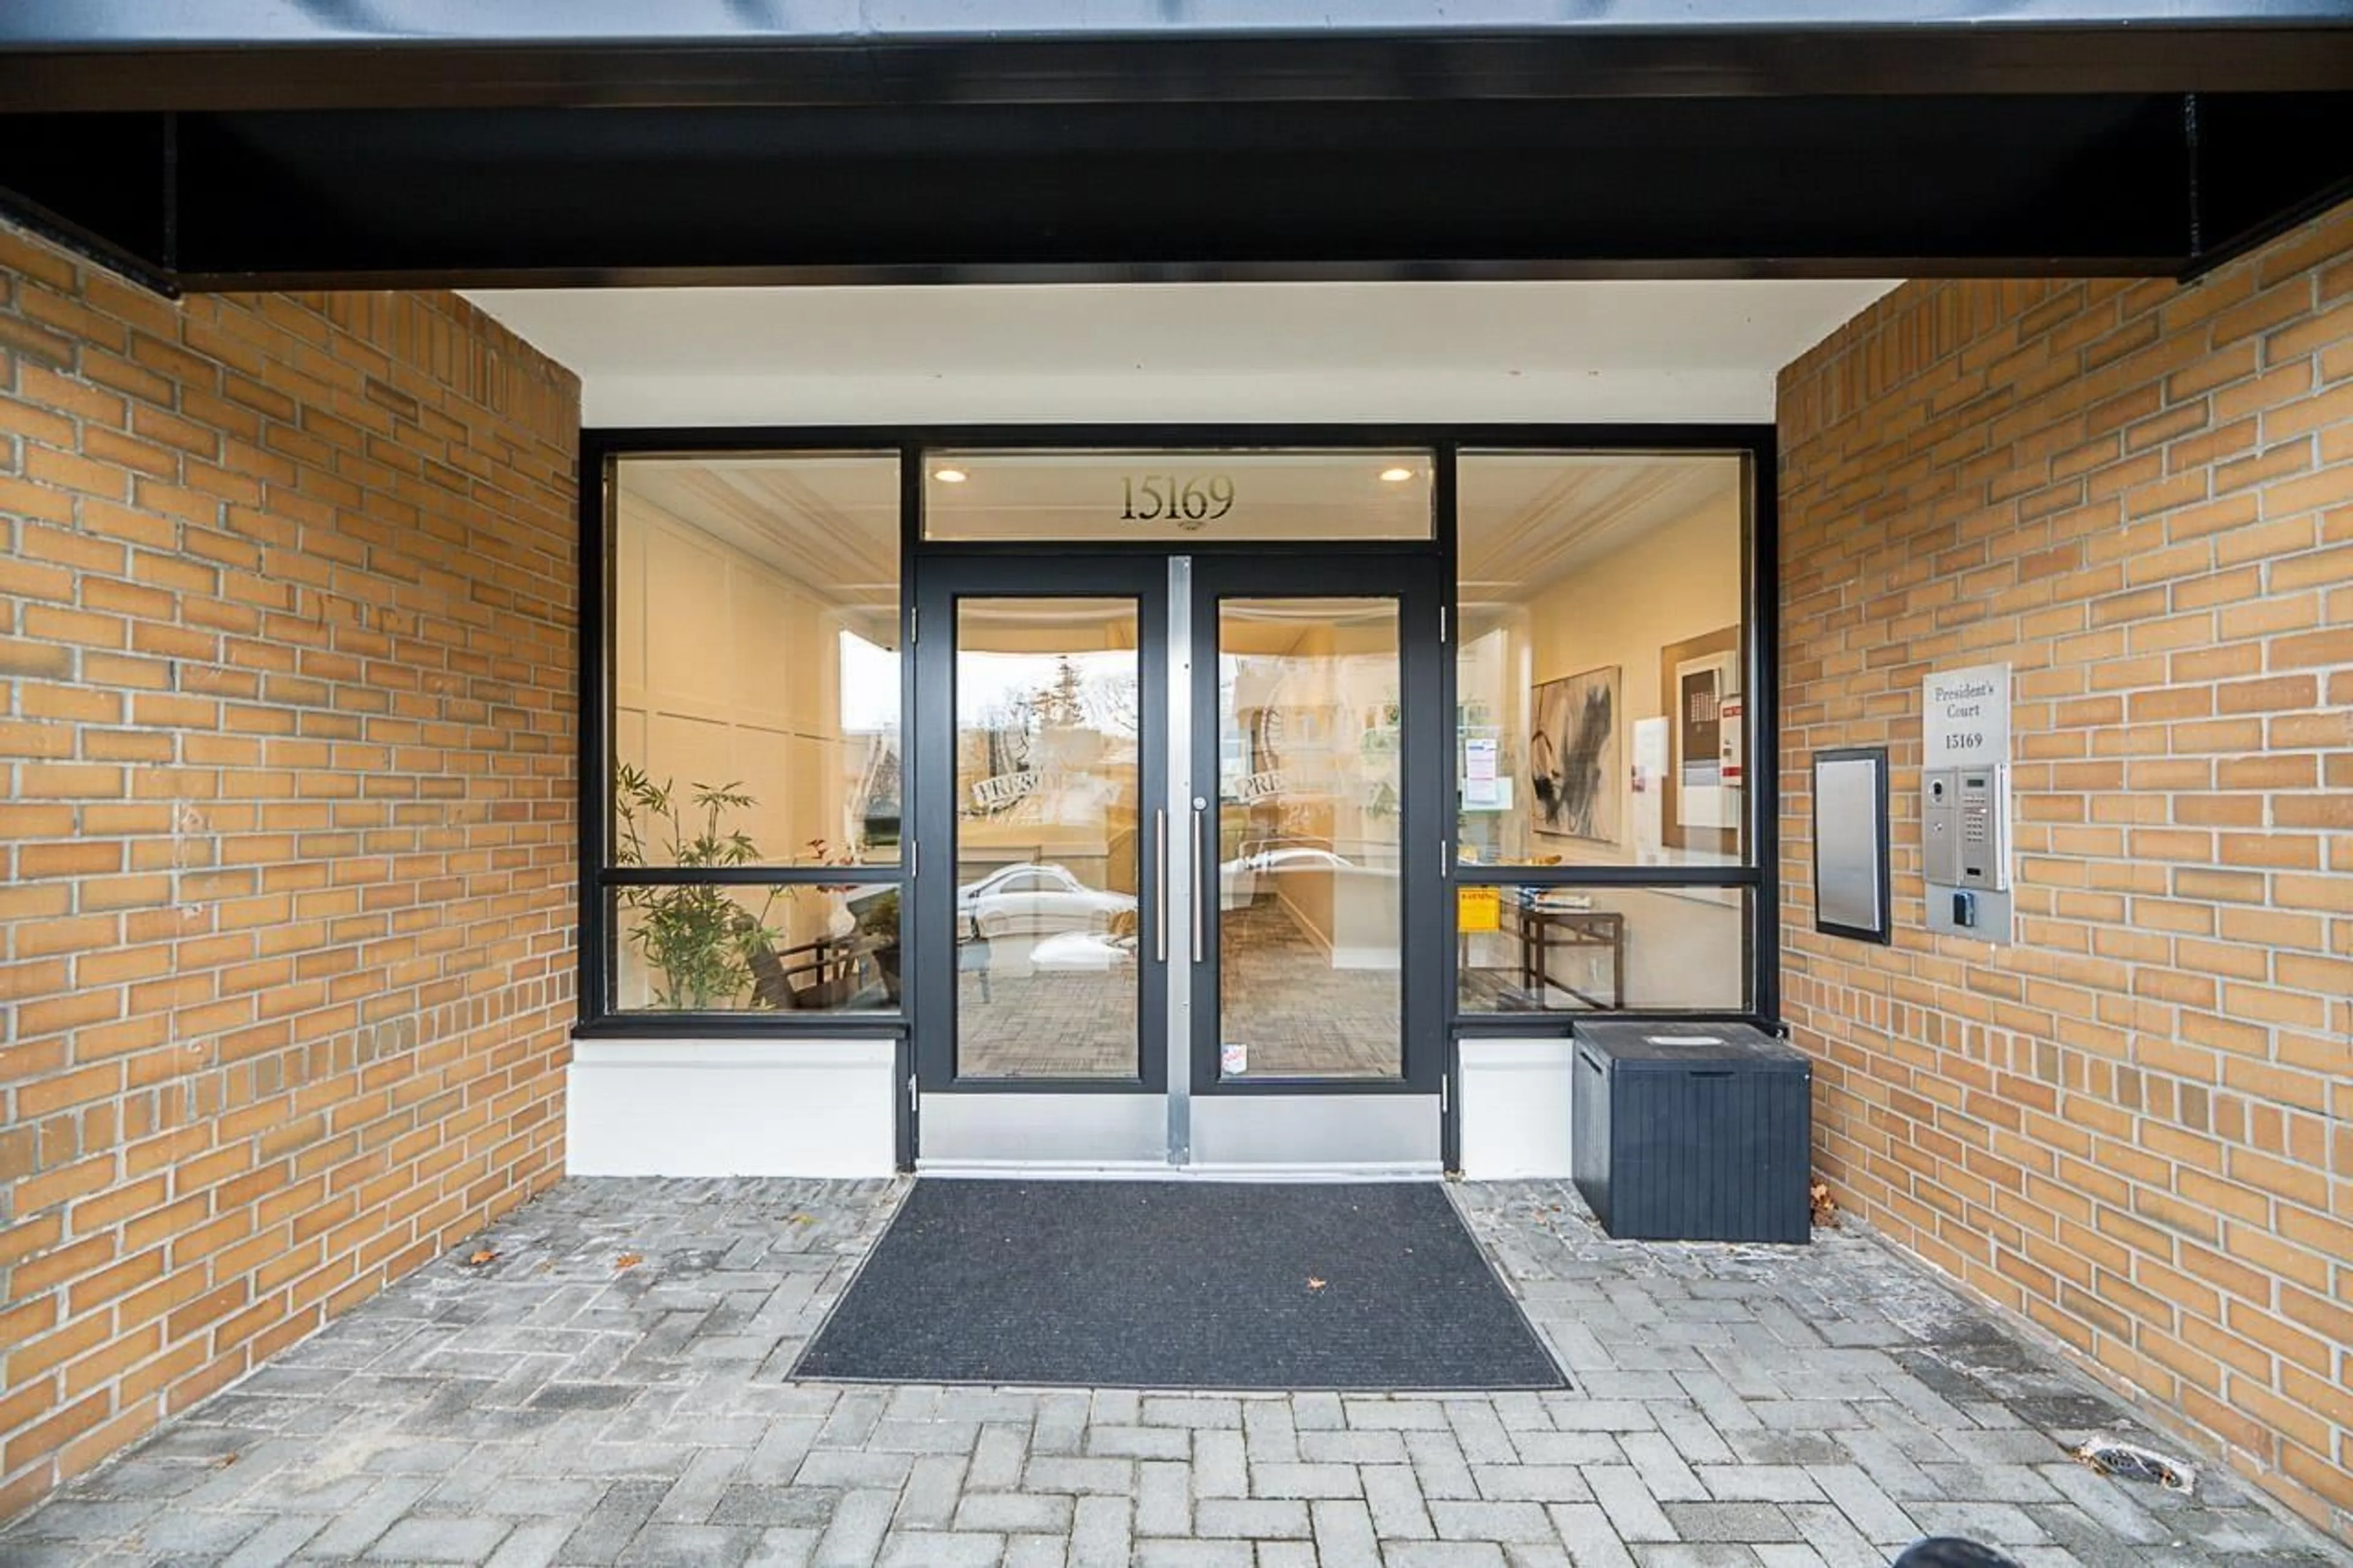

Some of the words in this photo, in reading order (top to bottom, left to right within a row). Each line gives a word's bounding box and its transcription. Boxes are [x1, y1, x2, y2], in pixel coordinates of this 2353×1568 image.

[1120, 474, 1234, 520] 15169
[1934, 680, 1993, 702] President's
[1946, 704, 1979, 718] Court
[1946, 733, 1983, 749] 15169
